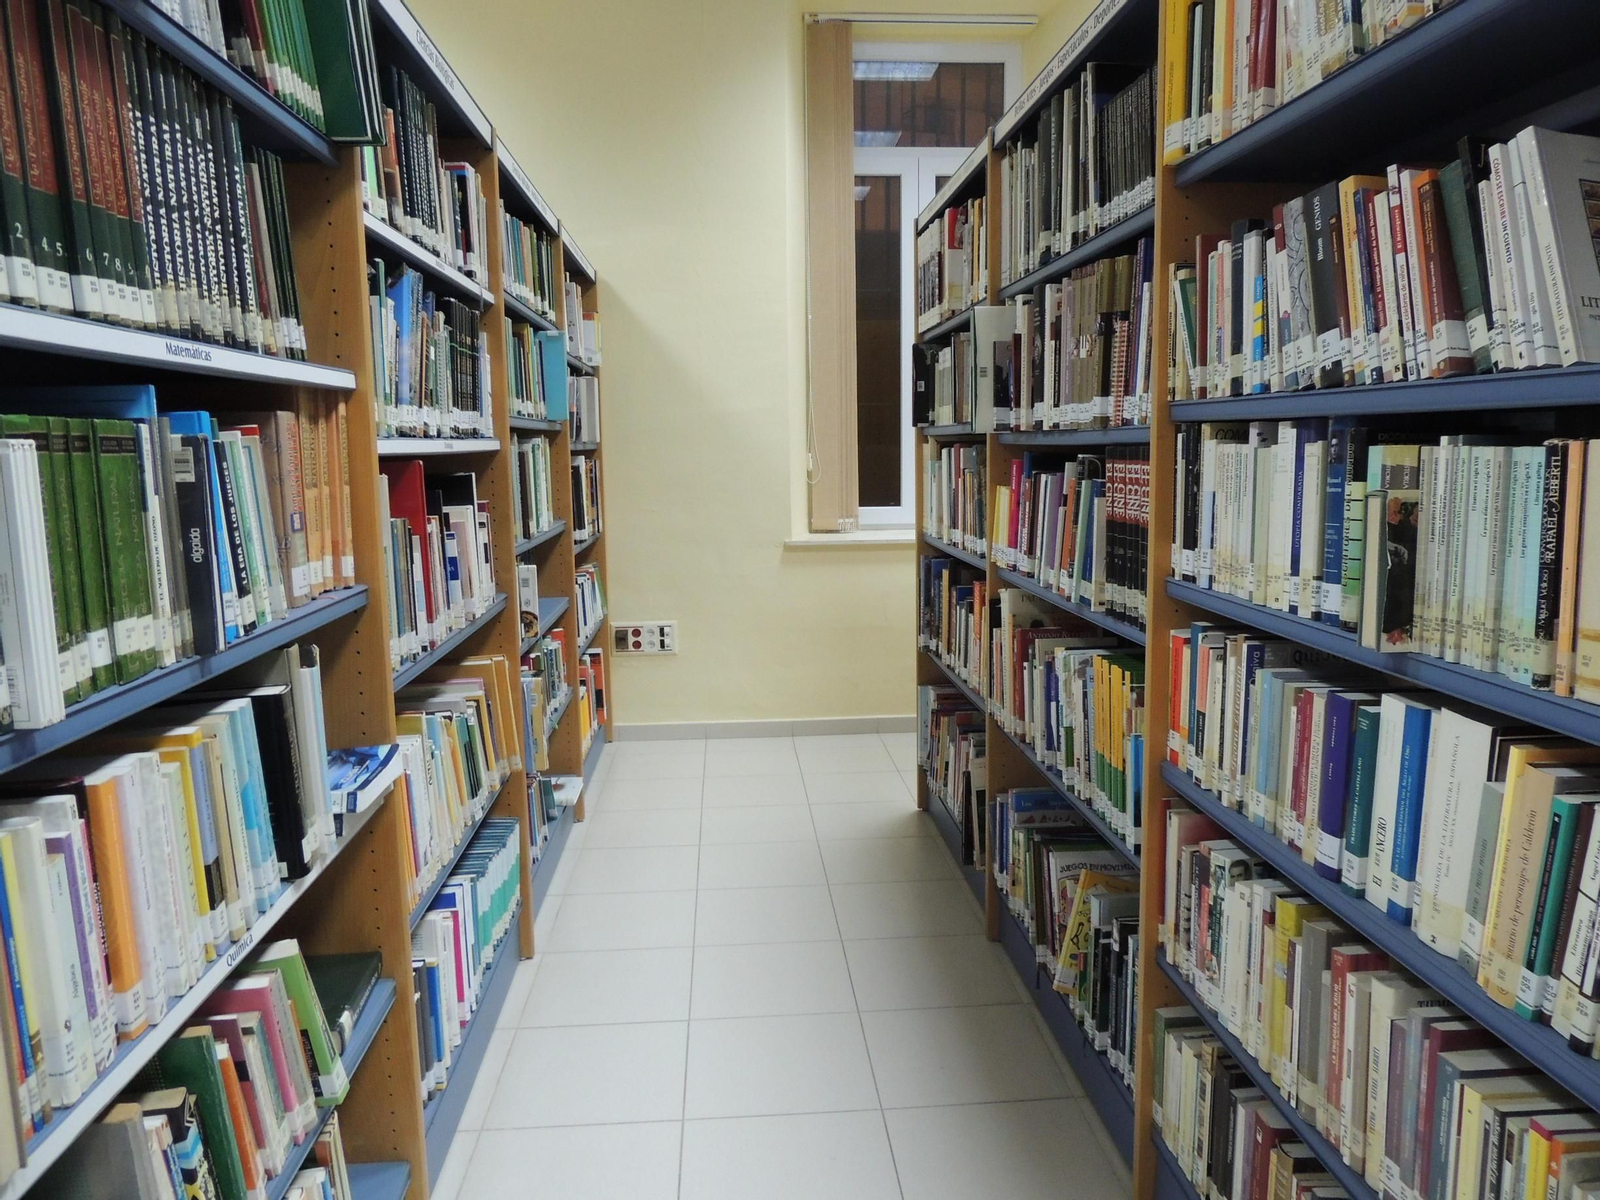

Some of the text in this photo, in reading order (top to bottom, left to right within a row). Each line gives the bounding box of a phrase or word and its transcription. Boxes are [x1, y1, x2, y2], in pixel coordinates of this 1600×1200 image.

[1057, 27, 1089, 69] Espectáculos
[1492, 158, 1502, 180] CÓMO
[1495, 180, 1502, 191] SE
[1313, 195, 1322, 231] GENIOS
[1496, 191, 1507, 220] ESCRIBE
[15, 222, 23, 238] 2
[1394, 209, 1402, 240] Hormiguero
[1501, 220, 1508, 232] UN
[41, 236, 48, 251] 4
[56, 242, 63, 256] 5
[159, 208, 174, 286] HISTORIA
[172, 212, 186, 291] HISTORIA
[1503, 233, 1513, 264] CUENTO
[103, 252, 109, 266] 7
[115, 258, 121, 272] 8
[1372, 247, 1380, 266] poético
[1398, 264, 1406, 282] niños
[1401, 283, 1407, 291] de
[1402, 292, 1410, 320] célebres
[165, 341, 212, 361] Matemáticas
[1215, 428, 1250, 440] COM
[1106, 463, 1112, 480] EL
[1118, 463, 1125, 482] EL
[1126, 464, 1133, 482] EL
[1133, 464, 1140, 482] EL
[1346, 442, 1355, 487] MUNDO
[222, 461, 234, 503] JUECES
[230, 506, 238, 527] LOS
[1545, 456, 1560, 563] RAFAEL ALBERTI
[189, 528, 204, 563] algaida
[234, 530, 241, 544] DE
[1342, 516, 1351, 588] ESCRITORES
[241, 570, 248, 584] LA
[1538, 599, 1549, 626] Miguel
[1232, 665, 1242, 723] Literaria
[1432, 735, 1460, 904] ONOLOGÍA DE LA LITERATURA ESPAÑOLA
[1372, 816, 1387, 888] EL ANCERO
[1060, 863, 1088, 873] JUEGOS
[1502, 809, 1538, 961] ionario de personajes de Calderón
[225, 932, 254, 966] Química
[1571, 918, 1583, 956] Literatura
[1575, 909, 1594, 977] Hispanoamericana
[1577, 1001, 1588, 1009] 821
[1331, 1022, 1339, 1052] TRILOGÍA
[1331, 1054, 1337, 1064] LA
[1372, 1045, 1380, 1074] ALBERTI
